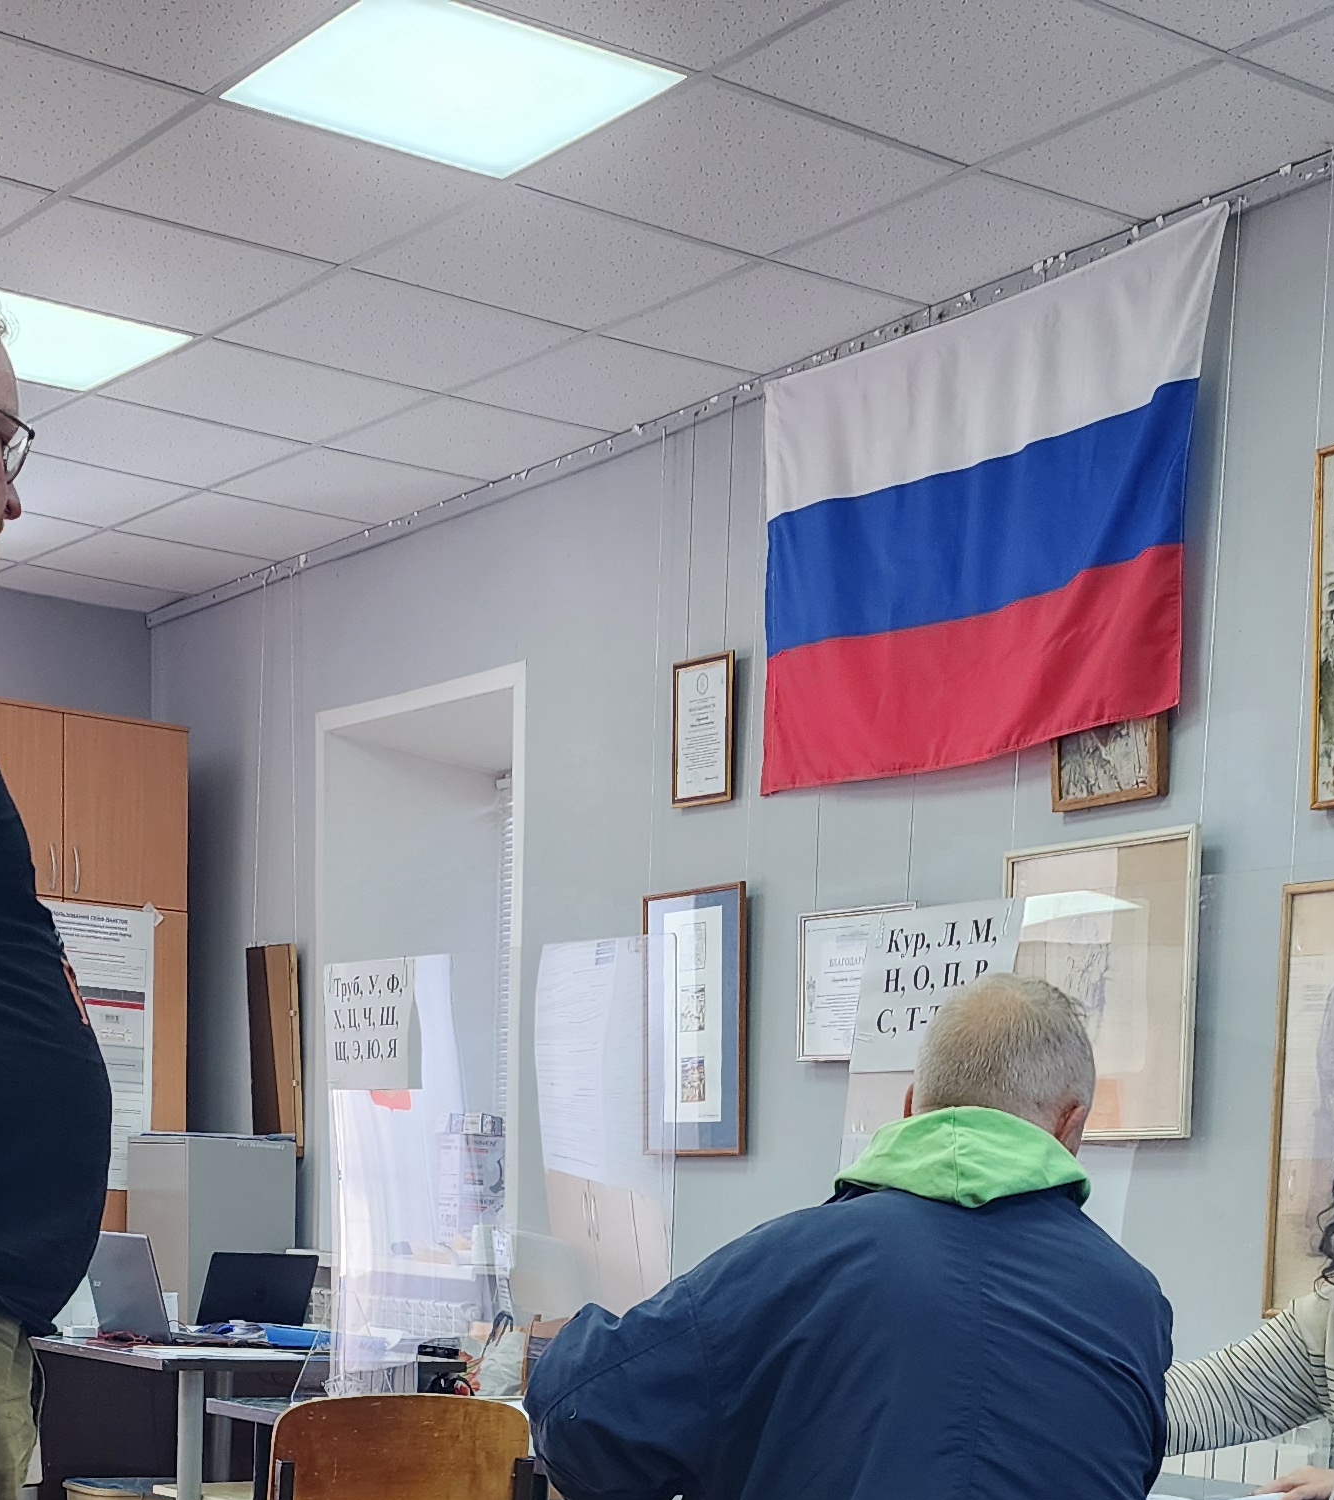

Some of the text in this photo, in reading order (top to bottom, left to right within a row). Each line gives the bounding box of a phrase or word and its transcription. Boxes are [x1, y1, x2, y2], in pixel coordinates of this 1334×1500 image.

[886, 927, 931, 958] Кур,
[937, 921, 961, 951] Л,
[967, 917, 997, 948] М,
[333, 973, 403, 1002] Труб, У, Ф,
[883, 967, 906, 998] Н,
[913, 965, 935, 995] О,
[333, 1005, 399, 1033] Х, Ц, Ч, Ш,
[876, 1009, 897, 1039] С,
[334, 1038, 398, 1064] Щ, Э, Ю, Я
